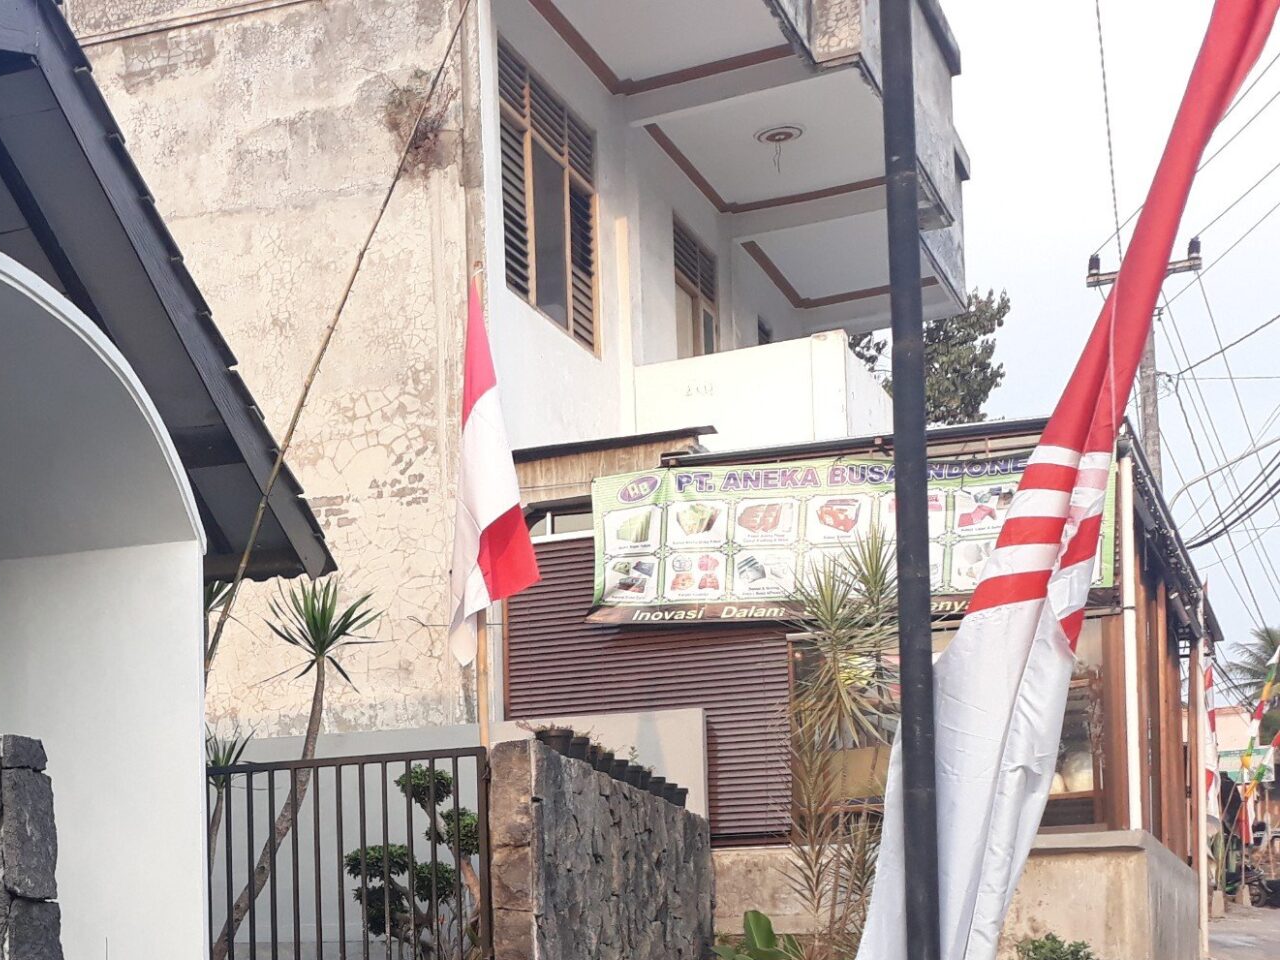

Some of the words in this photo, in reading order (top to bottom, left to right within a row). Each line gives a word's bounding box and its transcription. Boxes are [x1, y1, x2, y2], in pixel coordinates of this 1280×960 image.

[675, 471, 715, 493] PT.
[720, 467, 821, 491] ANEKA
[631, 606, 705, 621] Inovasi
[720, 604, 786, 619] Dalam
